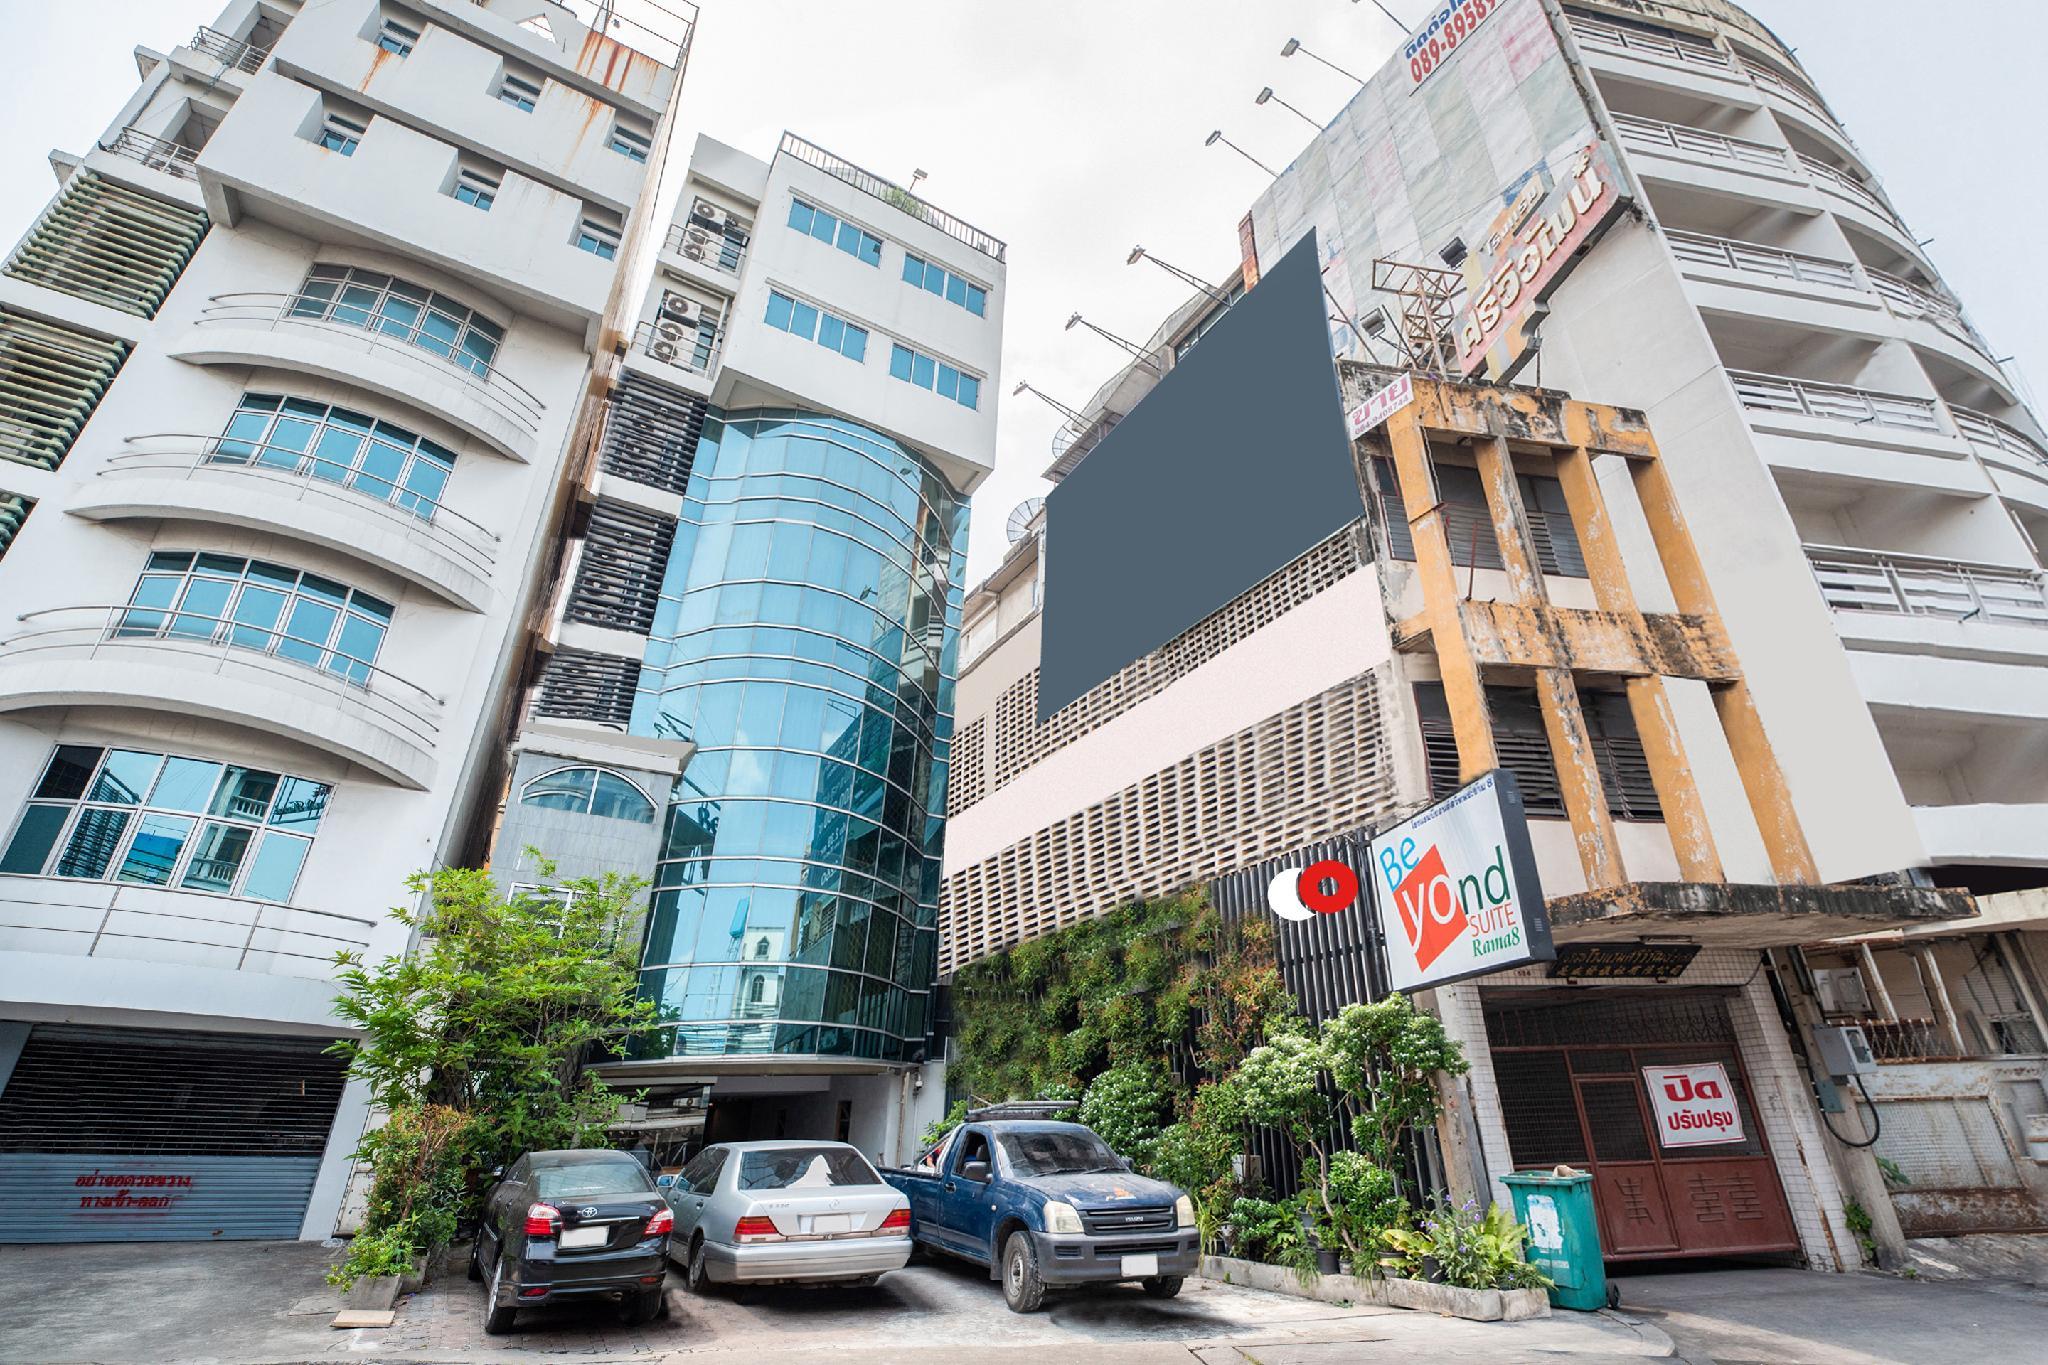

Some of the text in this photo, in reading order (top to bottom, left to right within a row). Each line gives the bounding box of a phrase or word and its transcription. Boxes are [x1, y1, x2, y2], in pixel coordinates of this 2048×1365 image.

[1353, 377, 1408, 425] ขาย
[1469, 903, 1517, 938] SUITE
[1472, 926, 1521, 957] Rama8
[1663, 1075, 1723, 1102] ปิด
[1667, 1108, 1733, 1133] ปรับปรุง
